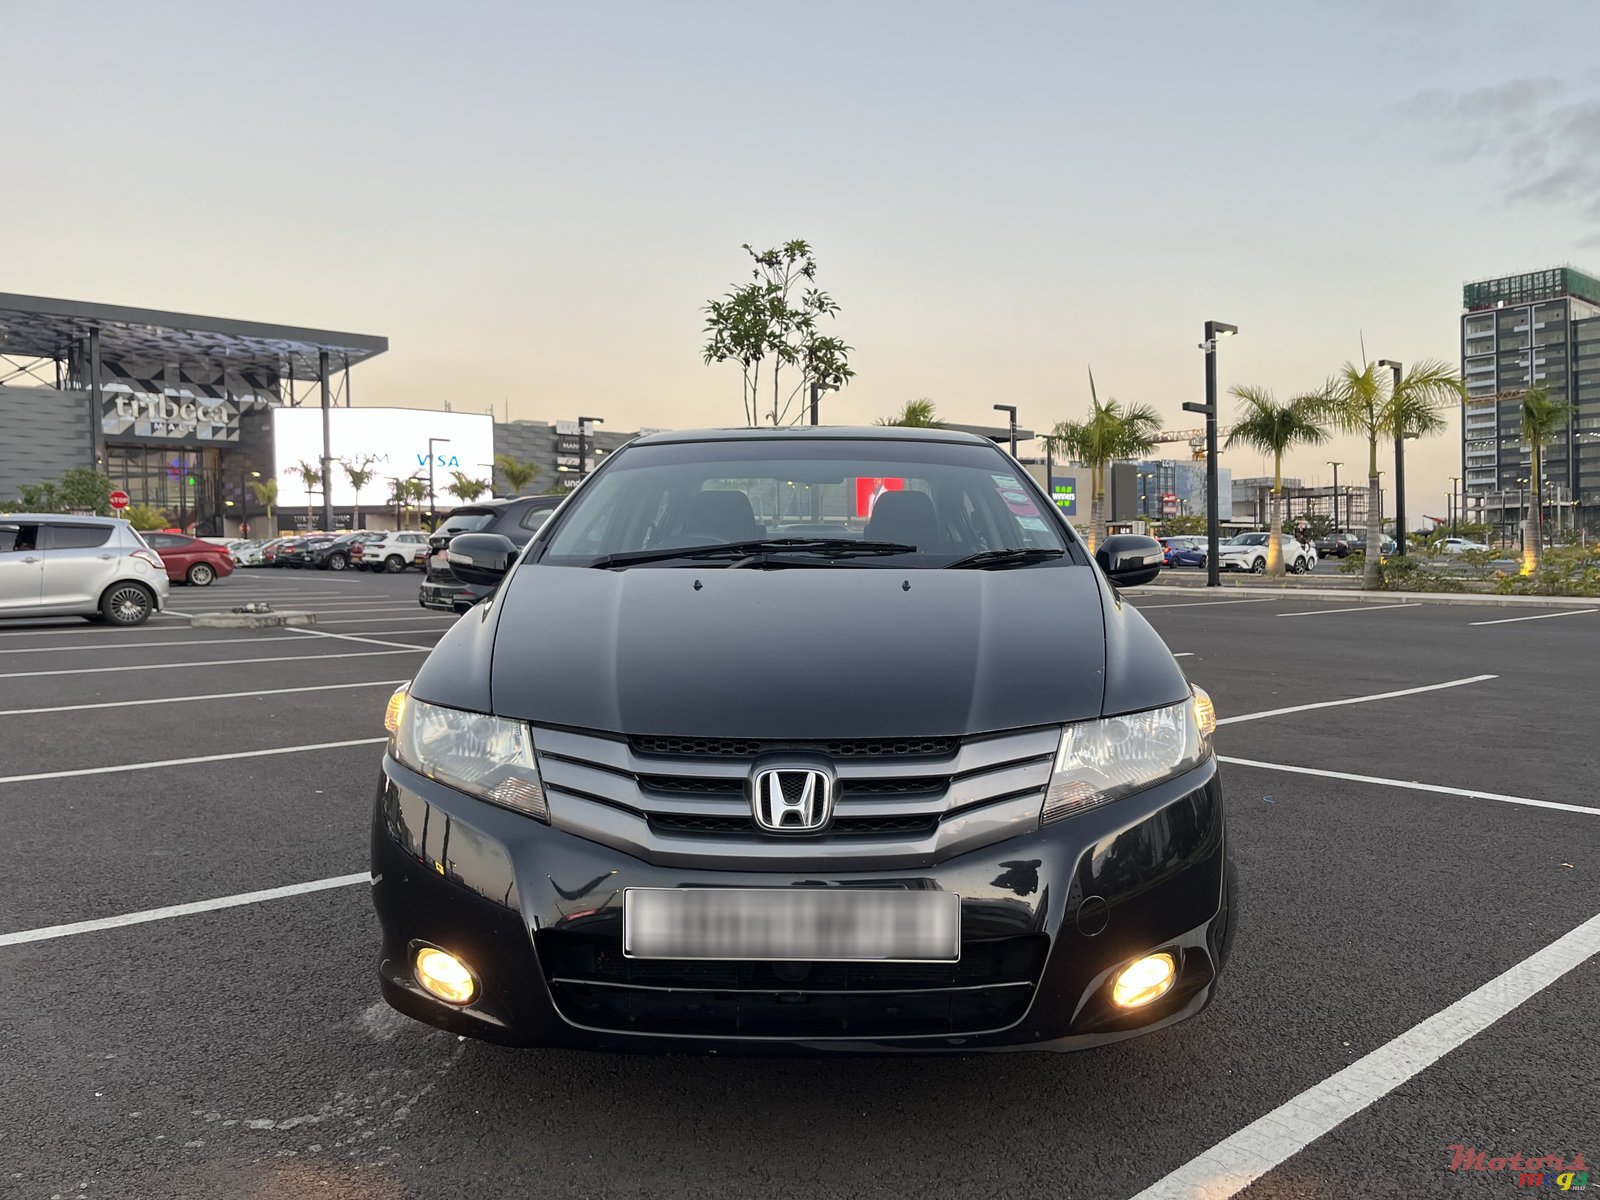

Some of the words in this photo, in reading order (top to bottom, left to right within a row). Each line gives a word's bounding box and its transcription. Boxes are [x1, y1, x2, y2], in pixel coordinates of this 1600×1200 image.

[115, 393, 229, 423] tribeca
[153, 422, 195, 432] MALL
[562, 442, 589, 450] MANO
[416, 453, 460, 467] VSA
